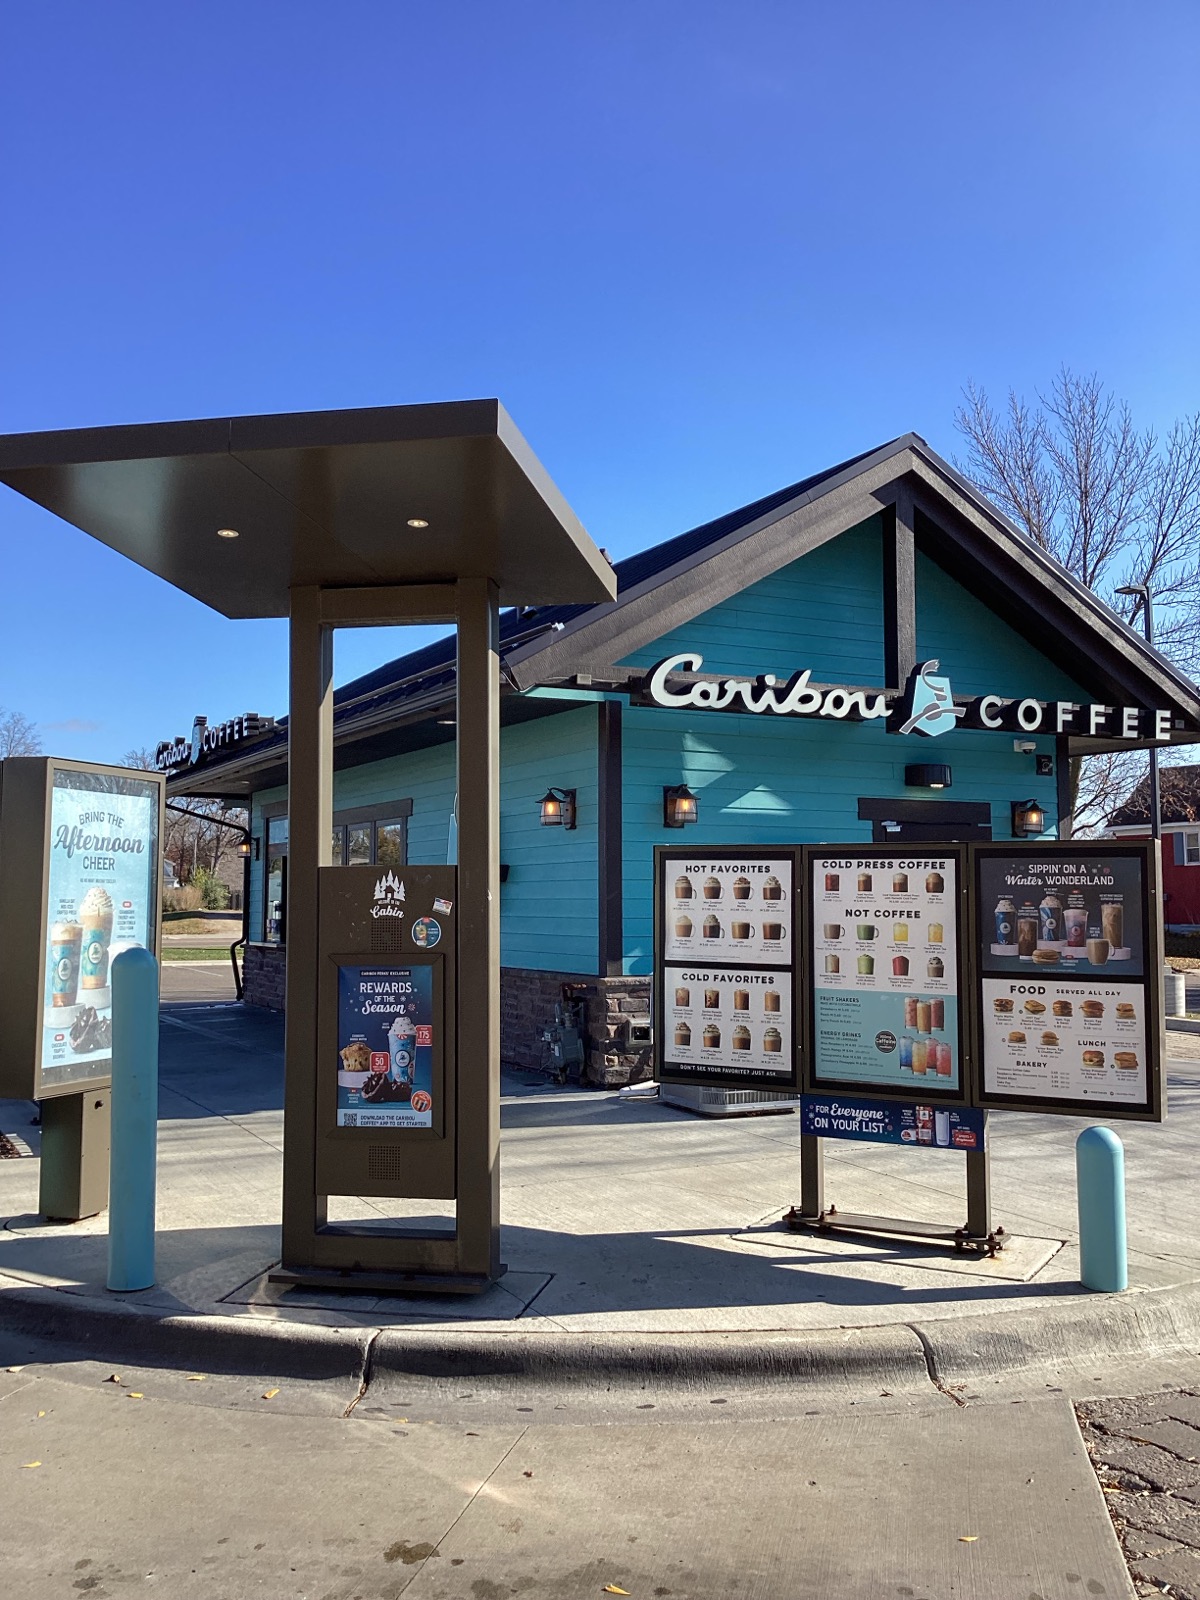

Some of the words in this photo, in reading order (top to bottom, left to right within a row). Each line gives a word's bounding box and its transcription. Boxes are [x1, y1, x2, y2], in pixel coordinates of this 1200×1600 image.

[649, 652, 894, 719] Caribou
[979, 694, 1172, 740] COFFEE
[154, 741, 191, 770] Caribou
[203, 713, 252, 751] COFFEE
[78, 811, 105, 825] BRING
[107, 812, 125, 828] THE
[53, 824, 145, 859] Afternoon
[82, 856, 116, 871] CHEER
[685, 865, 707, 873] HOT
[711, 865, 771, 873] FAVORITES
[821, 861, 853, 869] COLD
[856, 861, 894, 869] PRESS
[898, 861, 946, 870] COFFEE
[1028, 864, 1061, 874] SIPPIN'
[1063, 864, 1077, 874] ON
[1079, 864, 1087, 874] A
[1004, 874, 1043, 885] Winter
[1045, 875, 1114, 885] WONDERLAND
[370, 905, 405, 919] Cabin
[845, 909, 869, 918] NOT
[874, 909, 921, 919] COFFEE
[681, 973, 709, 981] COLD
[713, 974, 775, 984] FAVORITES
[359, 982, 412, 993] REWARDS
[1010, 985, 1046, 995] FOOD
[374, 995, 383, 1003] OF
[383, 995, 396, 1003] THE
[361, 999, 406, 1015] Season
[419, 1031, 430, 1039] 175
[375, 1057, 384, 1066] 50
[815, 1104, 829, 1114] FOR
[829, 1103, 884, 1123] Everyone
[814, 1117, 829, 1128] ON
[831, 1119, 860, 1131] YOUR
[862, 1121, 885, 1134] LIST
